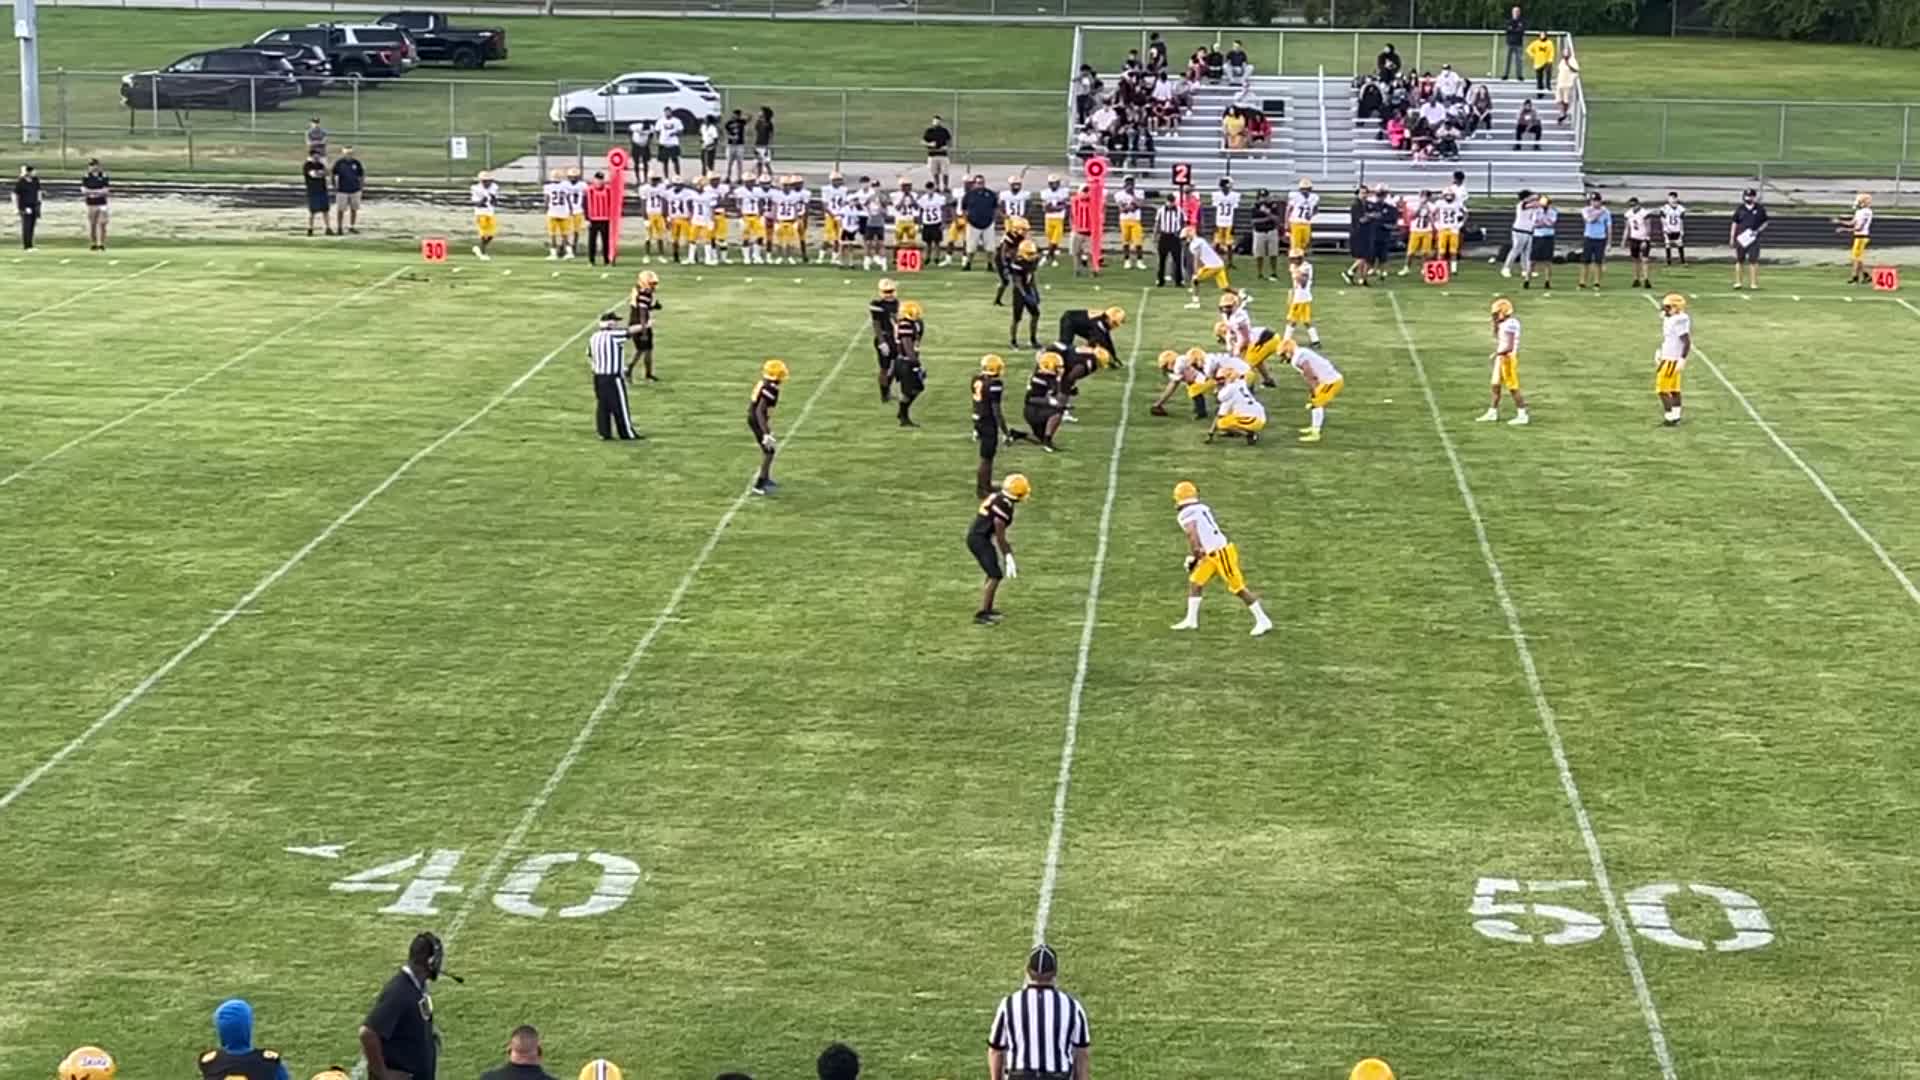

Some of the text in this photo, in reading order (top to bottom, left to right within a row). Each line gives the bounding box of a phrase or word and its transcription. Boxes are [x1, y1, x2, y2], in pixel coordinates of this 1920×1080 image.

[1174, 165, 1188, 182] 2
[425, 242, 444, 259] 30
[900, 252, 918, 269] 40
[1427, 263, 1446, 280] 50
[1876, 271, 1895, 288] 40
[328, 848, 641, 917] 40
[1467, 876, 1775, 951] 50
